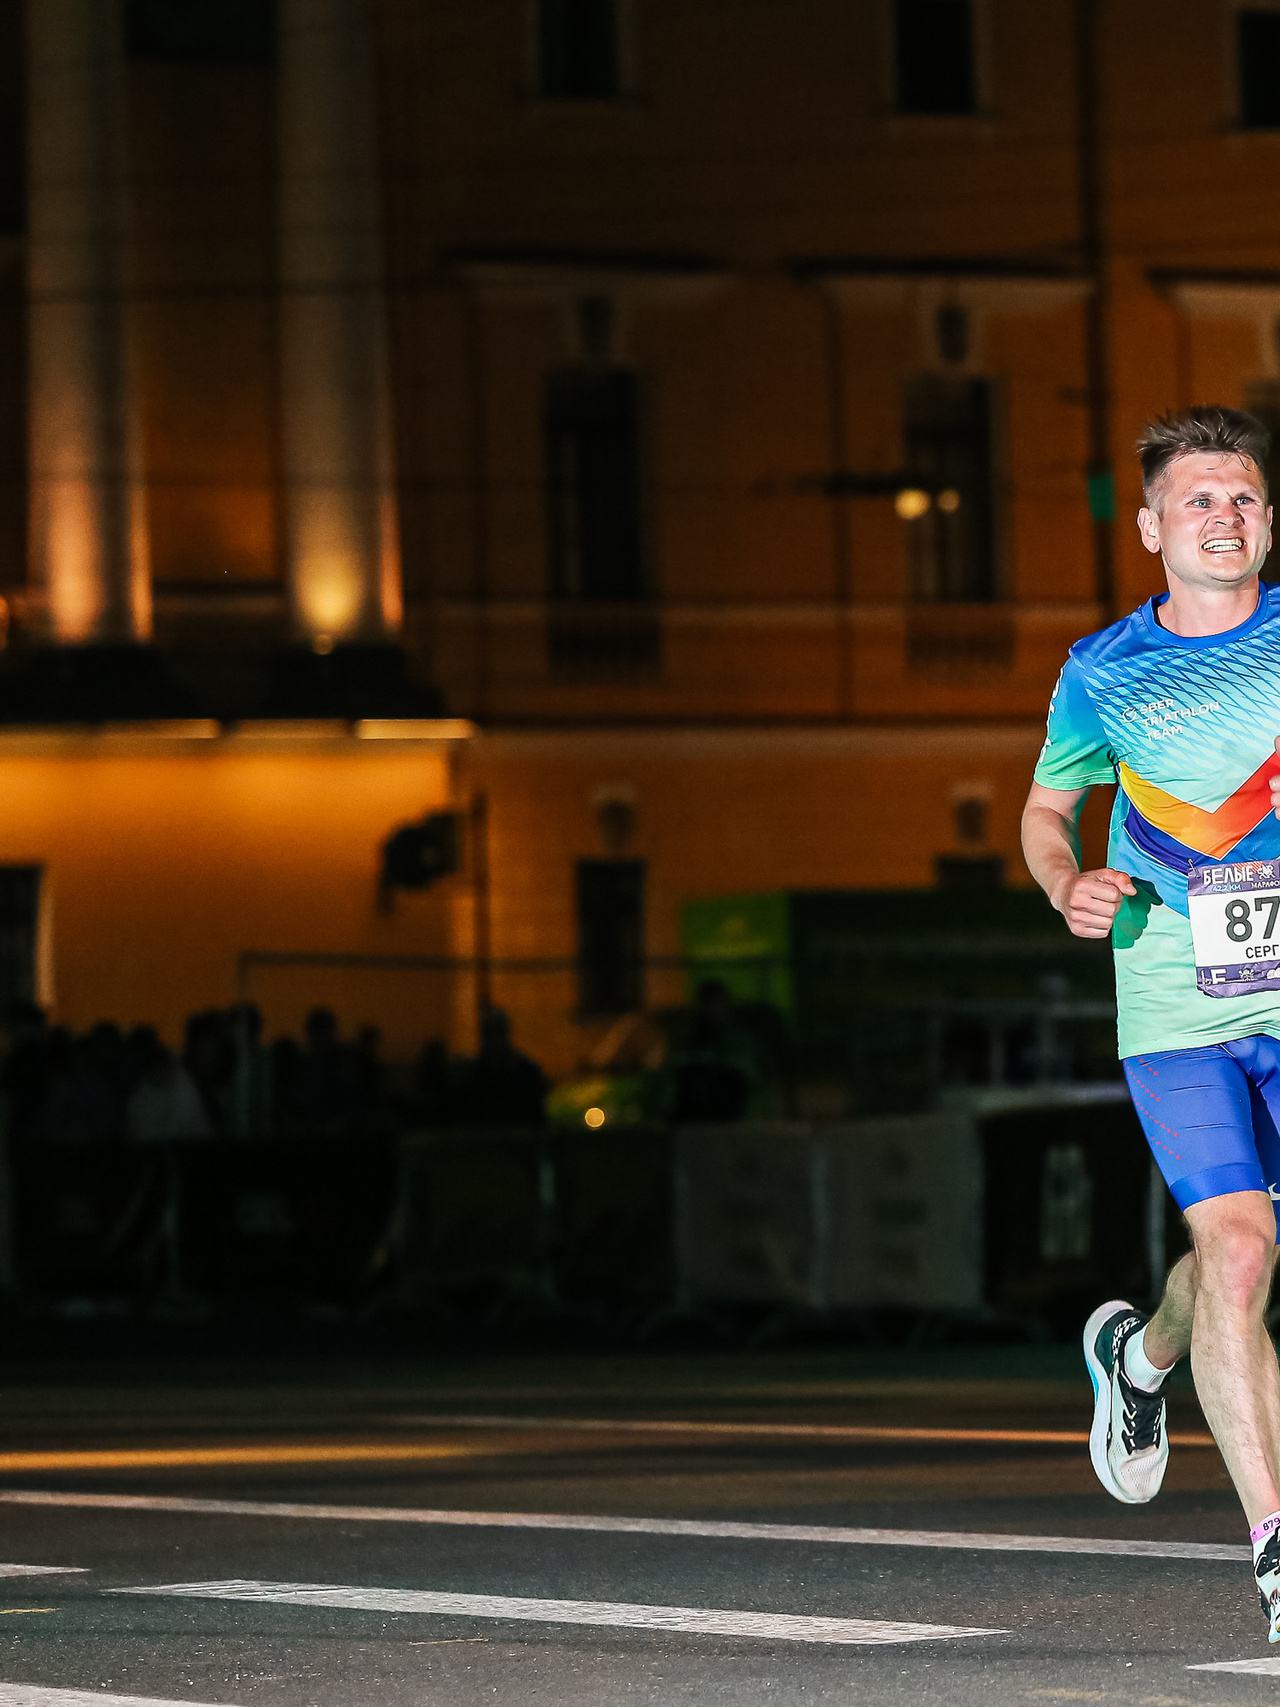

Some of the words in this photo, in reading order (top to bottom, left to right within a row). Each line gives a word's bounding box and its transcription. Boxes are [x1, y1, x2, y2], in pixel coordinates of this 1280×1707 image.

[1140, 699, 1175, 714] SBER
[1142, 702, 1220, 728] TRIATHLON
[1146, 725, 1184, 742] TEAM
[1203, 865, 1254, 885] БЕЛЫЕ
[1263, 1518, 1280, 1530] 879
